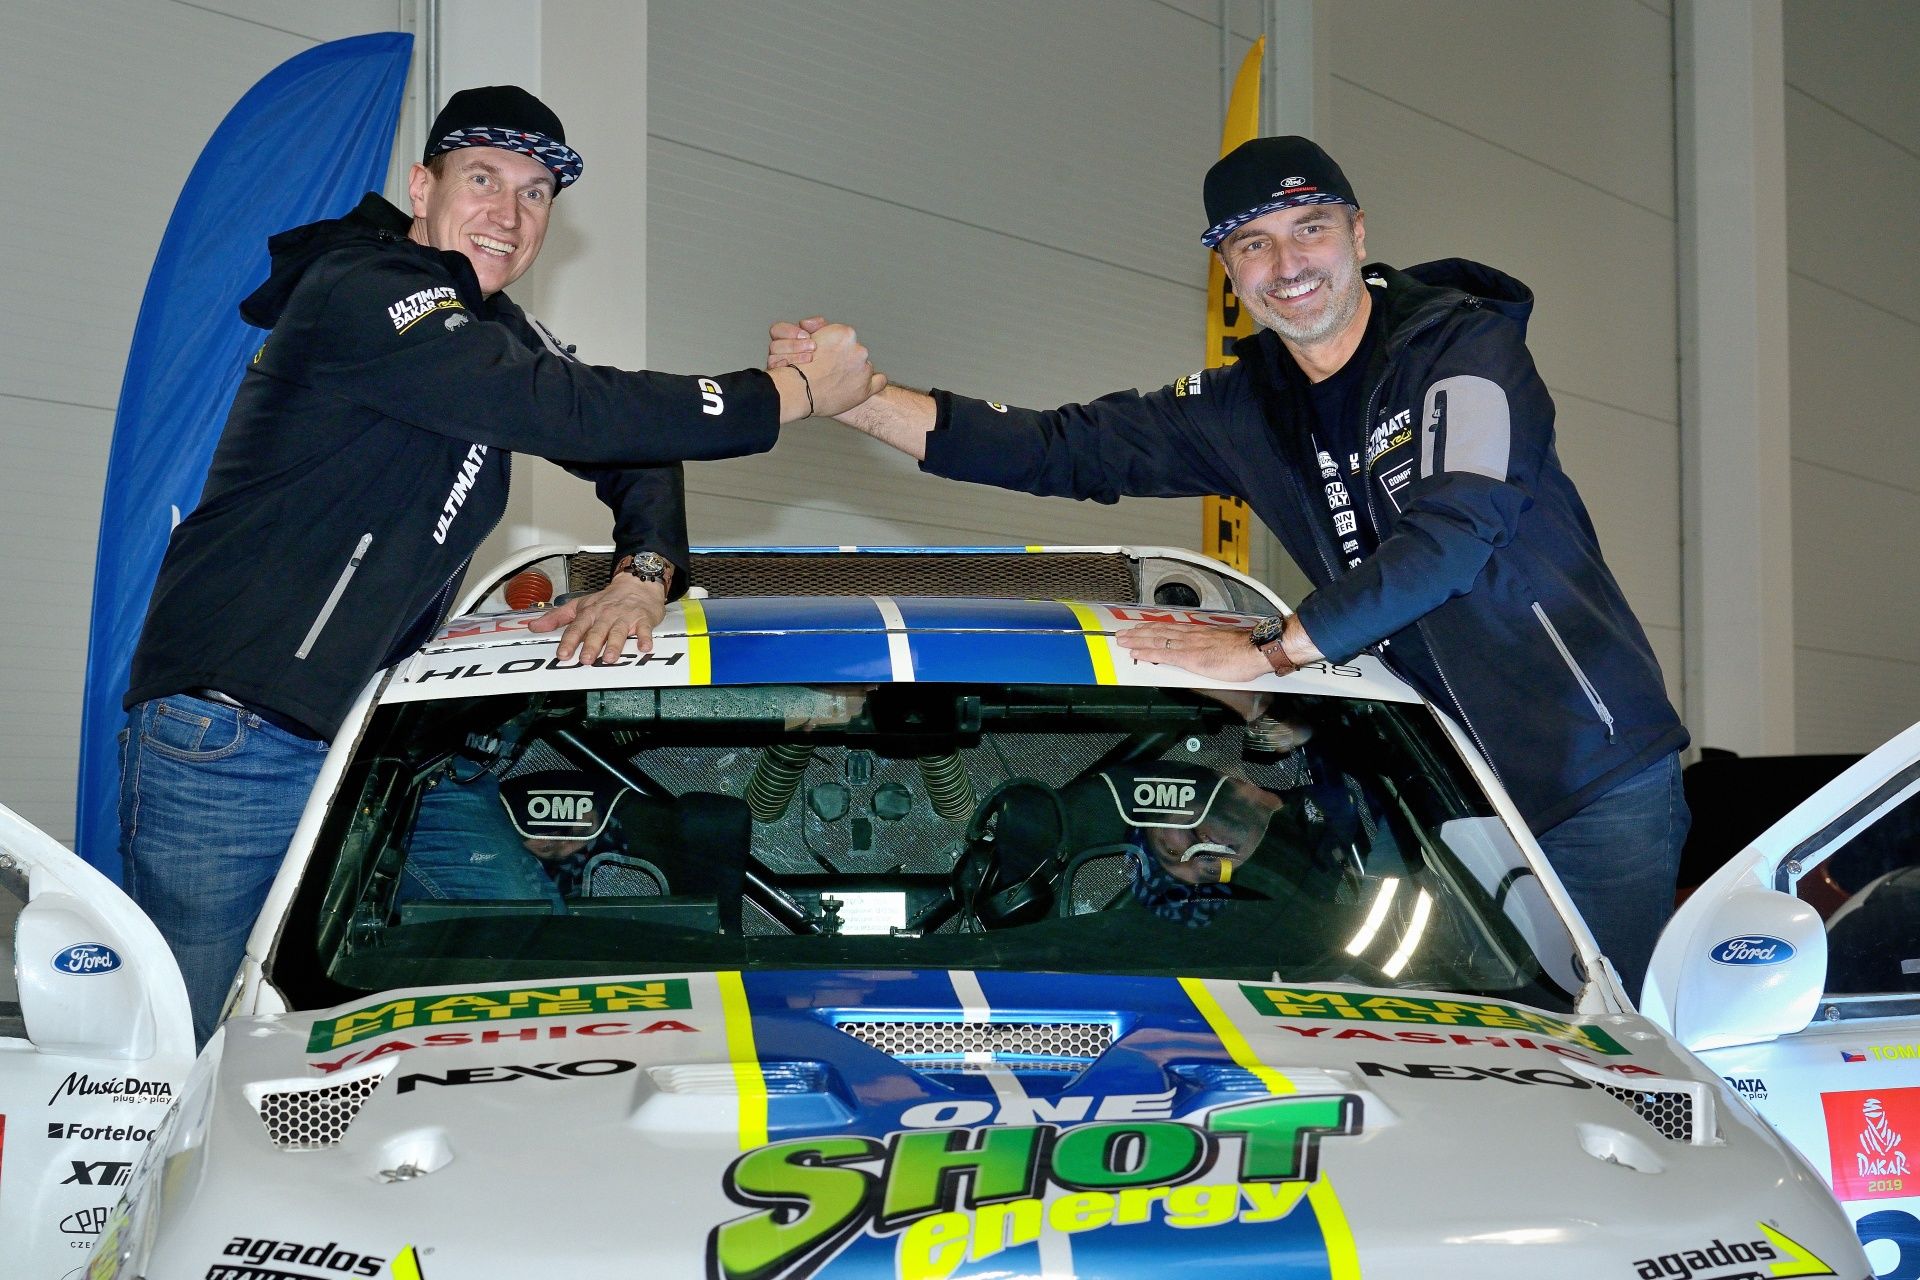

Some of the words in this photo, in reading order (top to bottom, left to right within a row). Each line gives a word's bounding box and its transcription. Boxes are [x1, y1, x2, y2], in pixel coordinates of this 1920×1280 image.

[1271, 190, 1284, 198] FORD
[387, 286, 457, 319] ULTIMATE
[392, 300, 437, 330] DAKAR
[527, 796, 594, 820] OMP
[1133, 783, 1196, 808] OMP
[68, 947, 113, 972] Ford
[1722, 939, 1777, 961] Ford
[337, 982, 666, 1030] MANN
[331, 996, 671, 1048] FILTER
[310, 1020, 701, 1073] YASHICA
[1275, 1025, 1664, 1076] YASHICA
[1868, 1044, 1920, 1061] TOM
[397, 1059, 637, 1095] NEXO
[1355, 1061, 1593, 1090] NEXO
[113, 1094, 135, 1103] plug
[150, 1093, 172, 1104] play
[900, 1087, 1177, 1128] ONE
[1749, 1092, 1768, 1100] play
[1856, 1150, 1911, 1177] DAKAR
[707, 1094, 1364, 1280] SHOT
[1868, 1179, 1903, 1192] 2019
[70, 1241, 95, 1249] CZE
[900, 1181, 1311, 1280] energy
[223, 1236, 386, 1277] agados
[1633, 1239, 1777, 1280] agados
